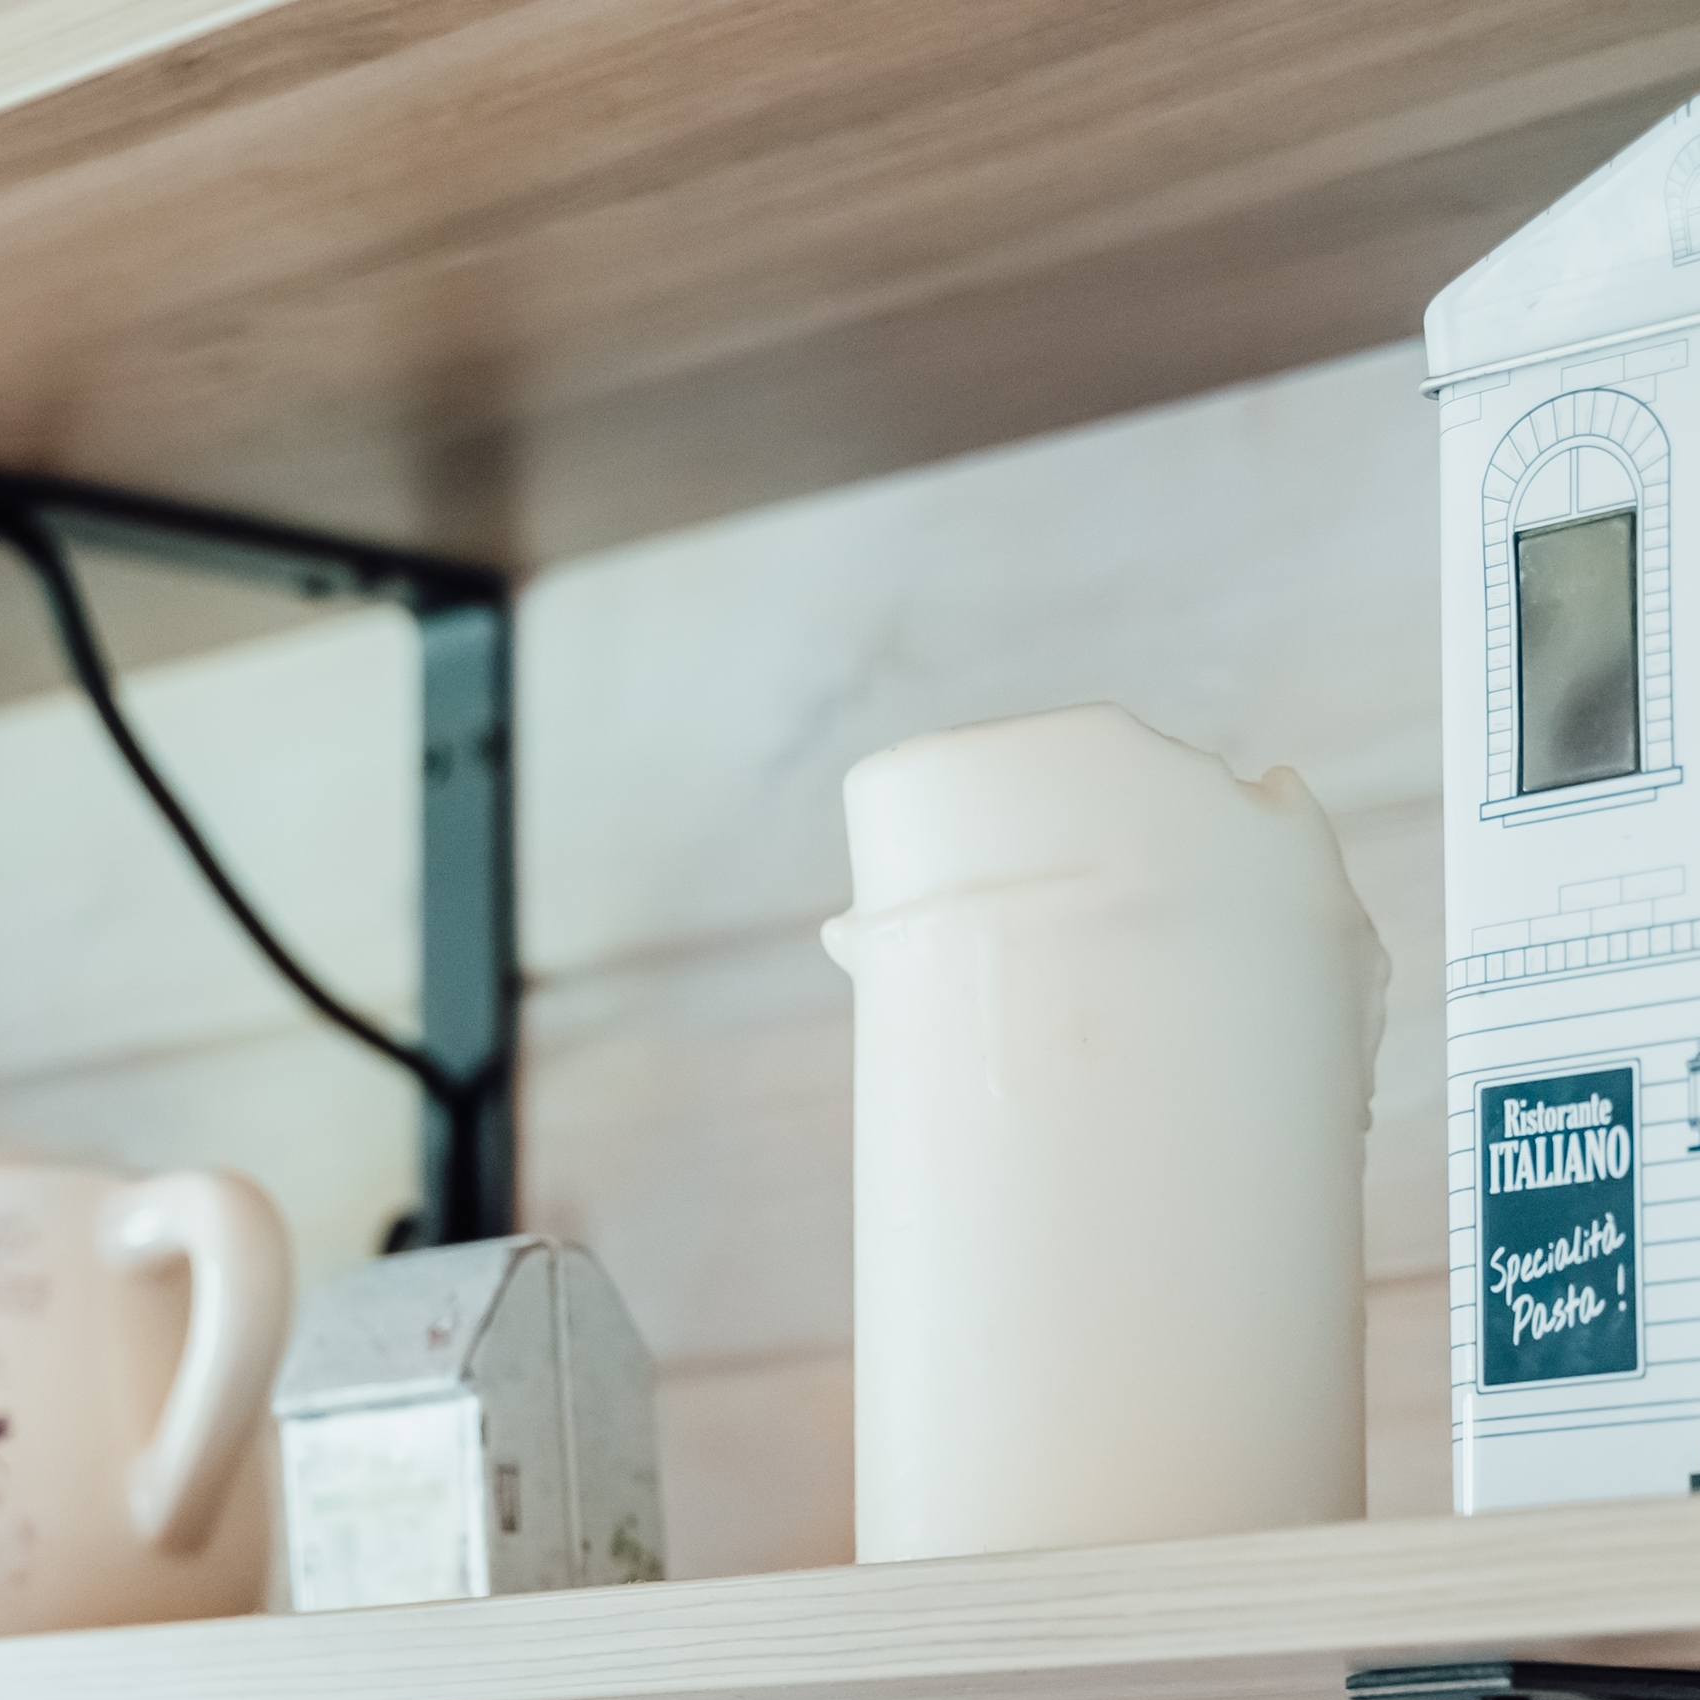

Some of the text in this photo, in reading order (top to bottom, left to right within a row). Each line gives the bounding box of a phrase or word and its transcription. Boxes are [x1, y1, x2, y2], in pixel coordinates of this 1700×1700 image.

[1503, 1092, 1613, 1138] Ristorante
[1489, 1124, 1631, 1194] ITALIANO
[1490, 1212, 1626, 1306] Specialità
[1511, 1283, 1606, 1346] Pasta
